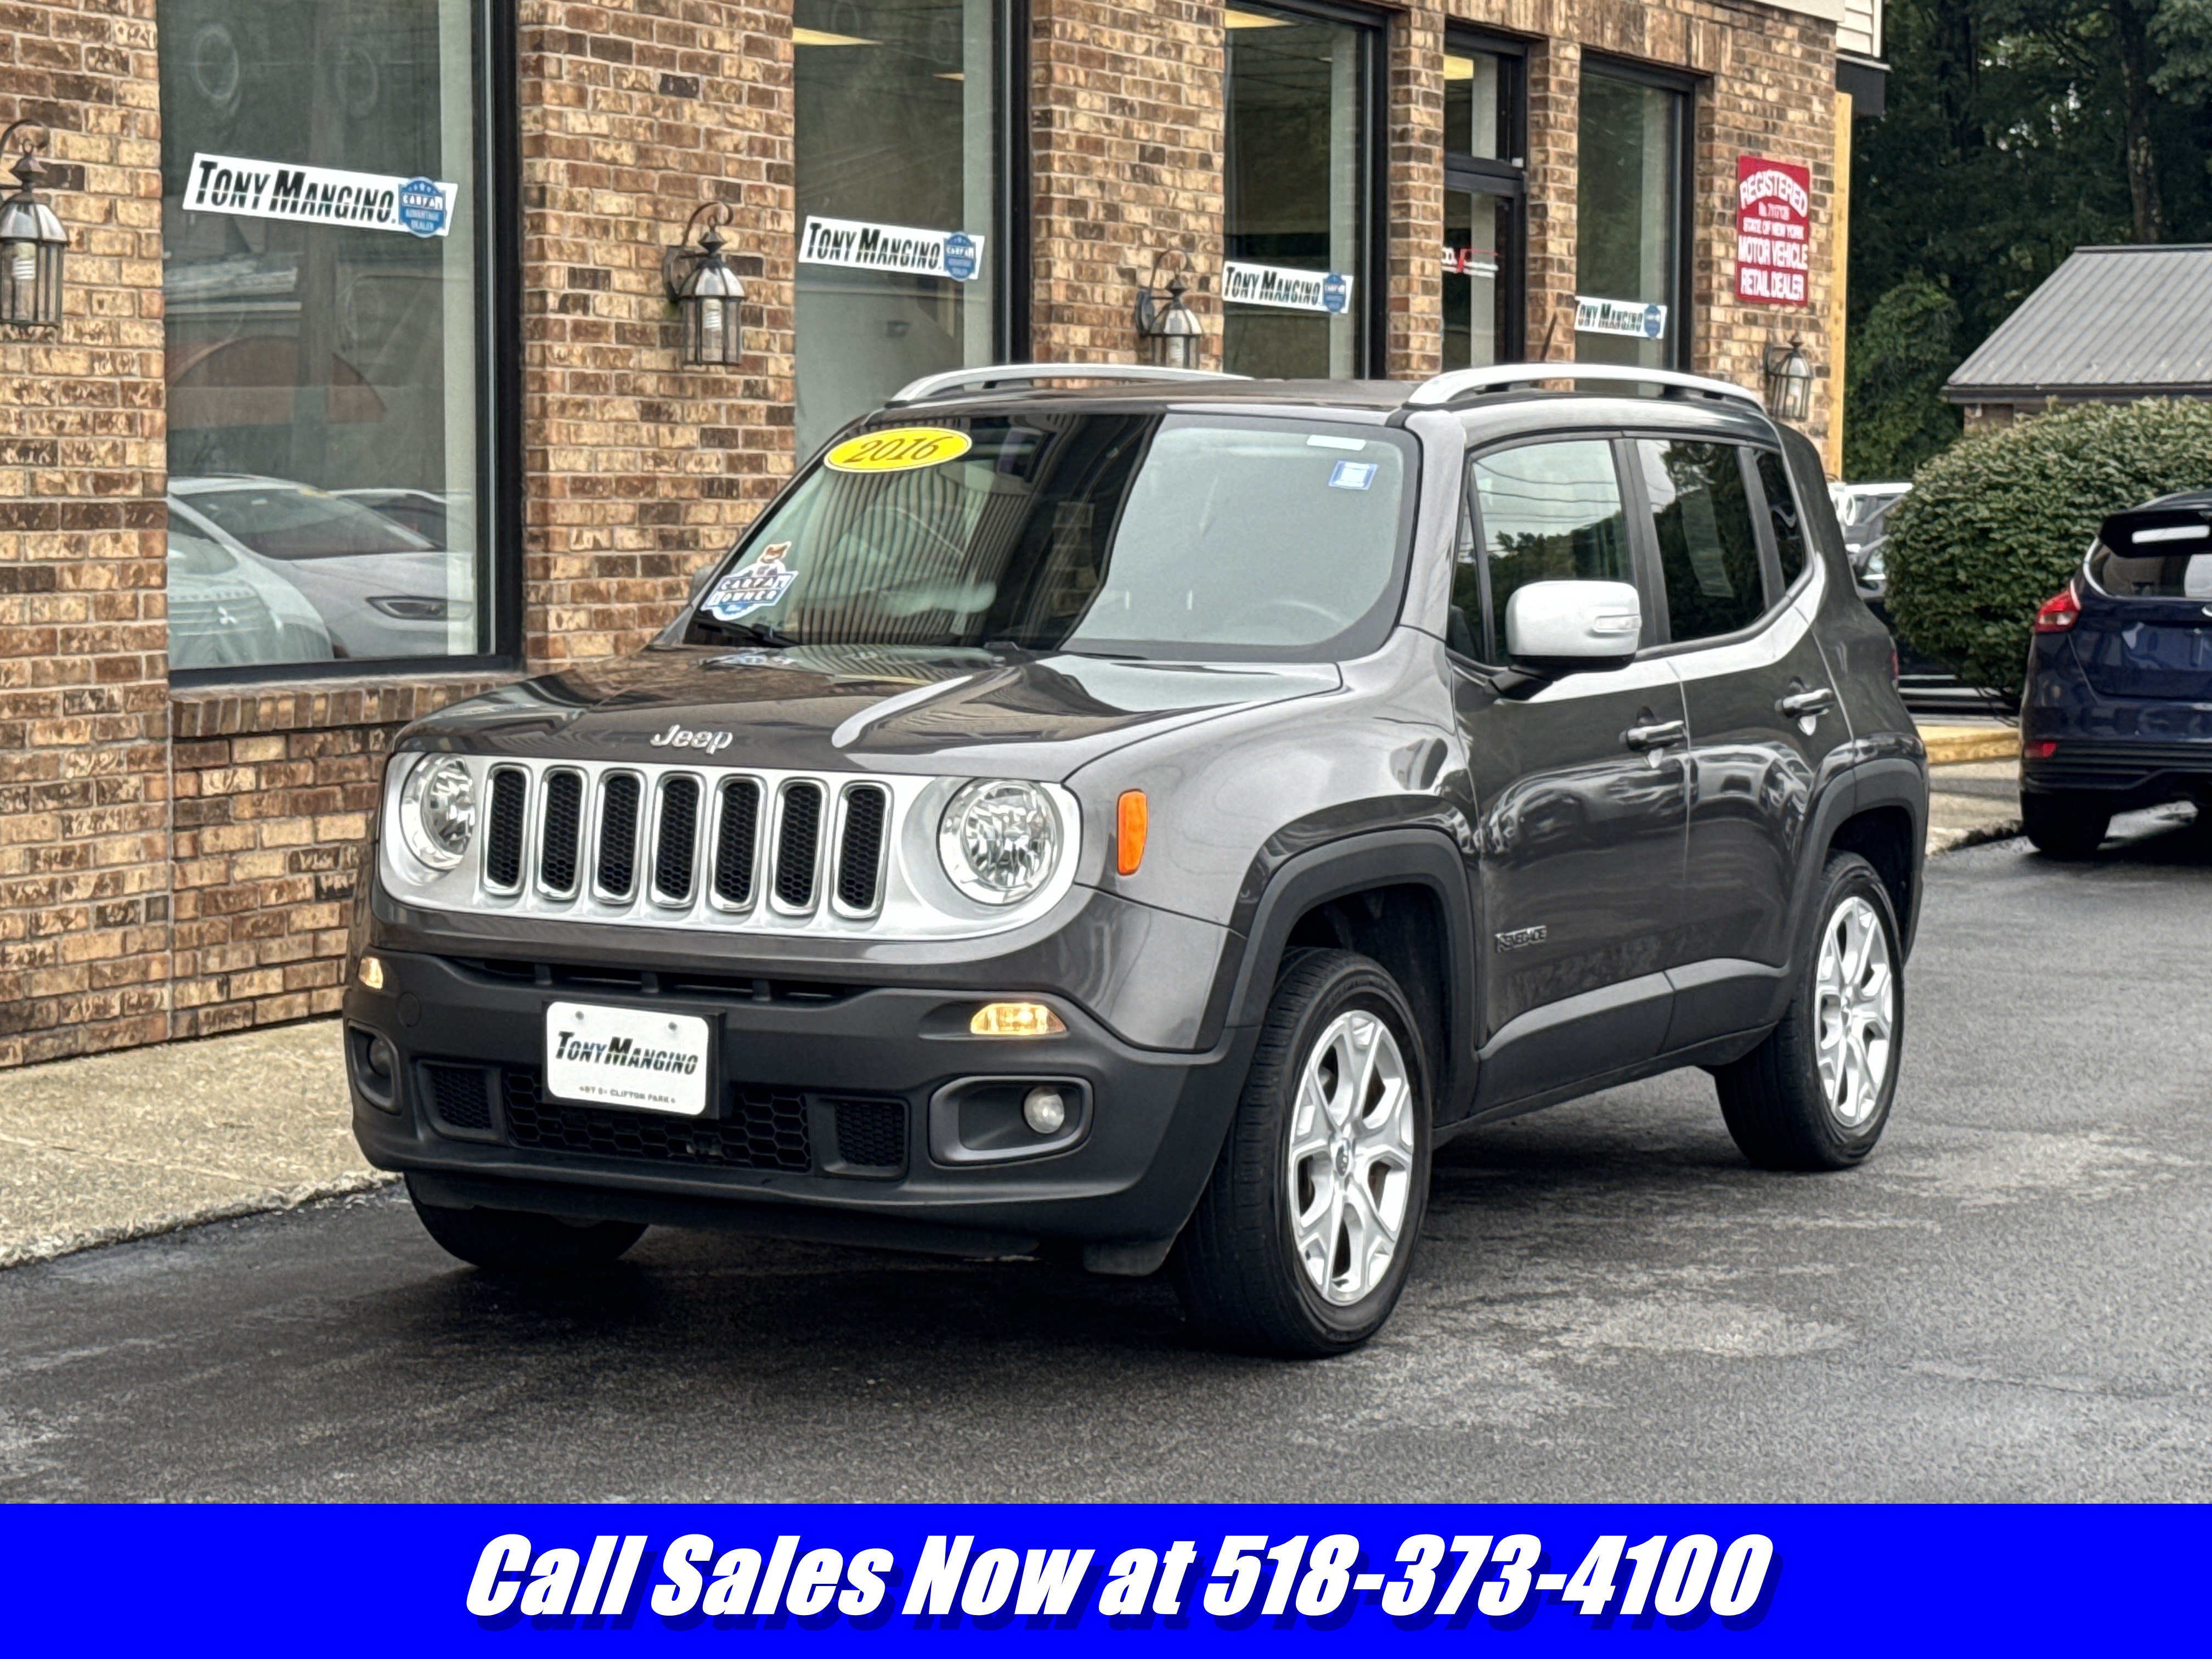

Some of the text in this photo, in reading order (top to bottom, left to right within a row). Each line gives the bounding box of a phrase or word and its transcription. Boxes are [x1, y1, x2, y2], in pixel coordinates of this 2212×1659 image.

[195, 160, 270, 210] TONY
[1740, 169, 1808, 218] REGISTERED
[806, 222, 857, 262] TONY
[1738, 235, 1808, 270] MOTOR VEHICLE
[1224, 266, 1260, 300] TONY
[1740, 267, 1804, 301] RETAIL DEALER
[1578, 303, 1599, 328] ONY
[842, 436, 953, 464] 2016
[650, 724, 733, 755] Jeep
